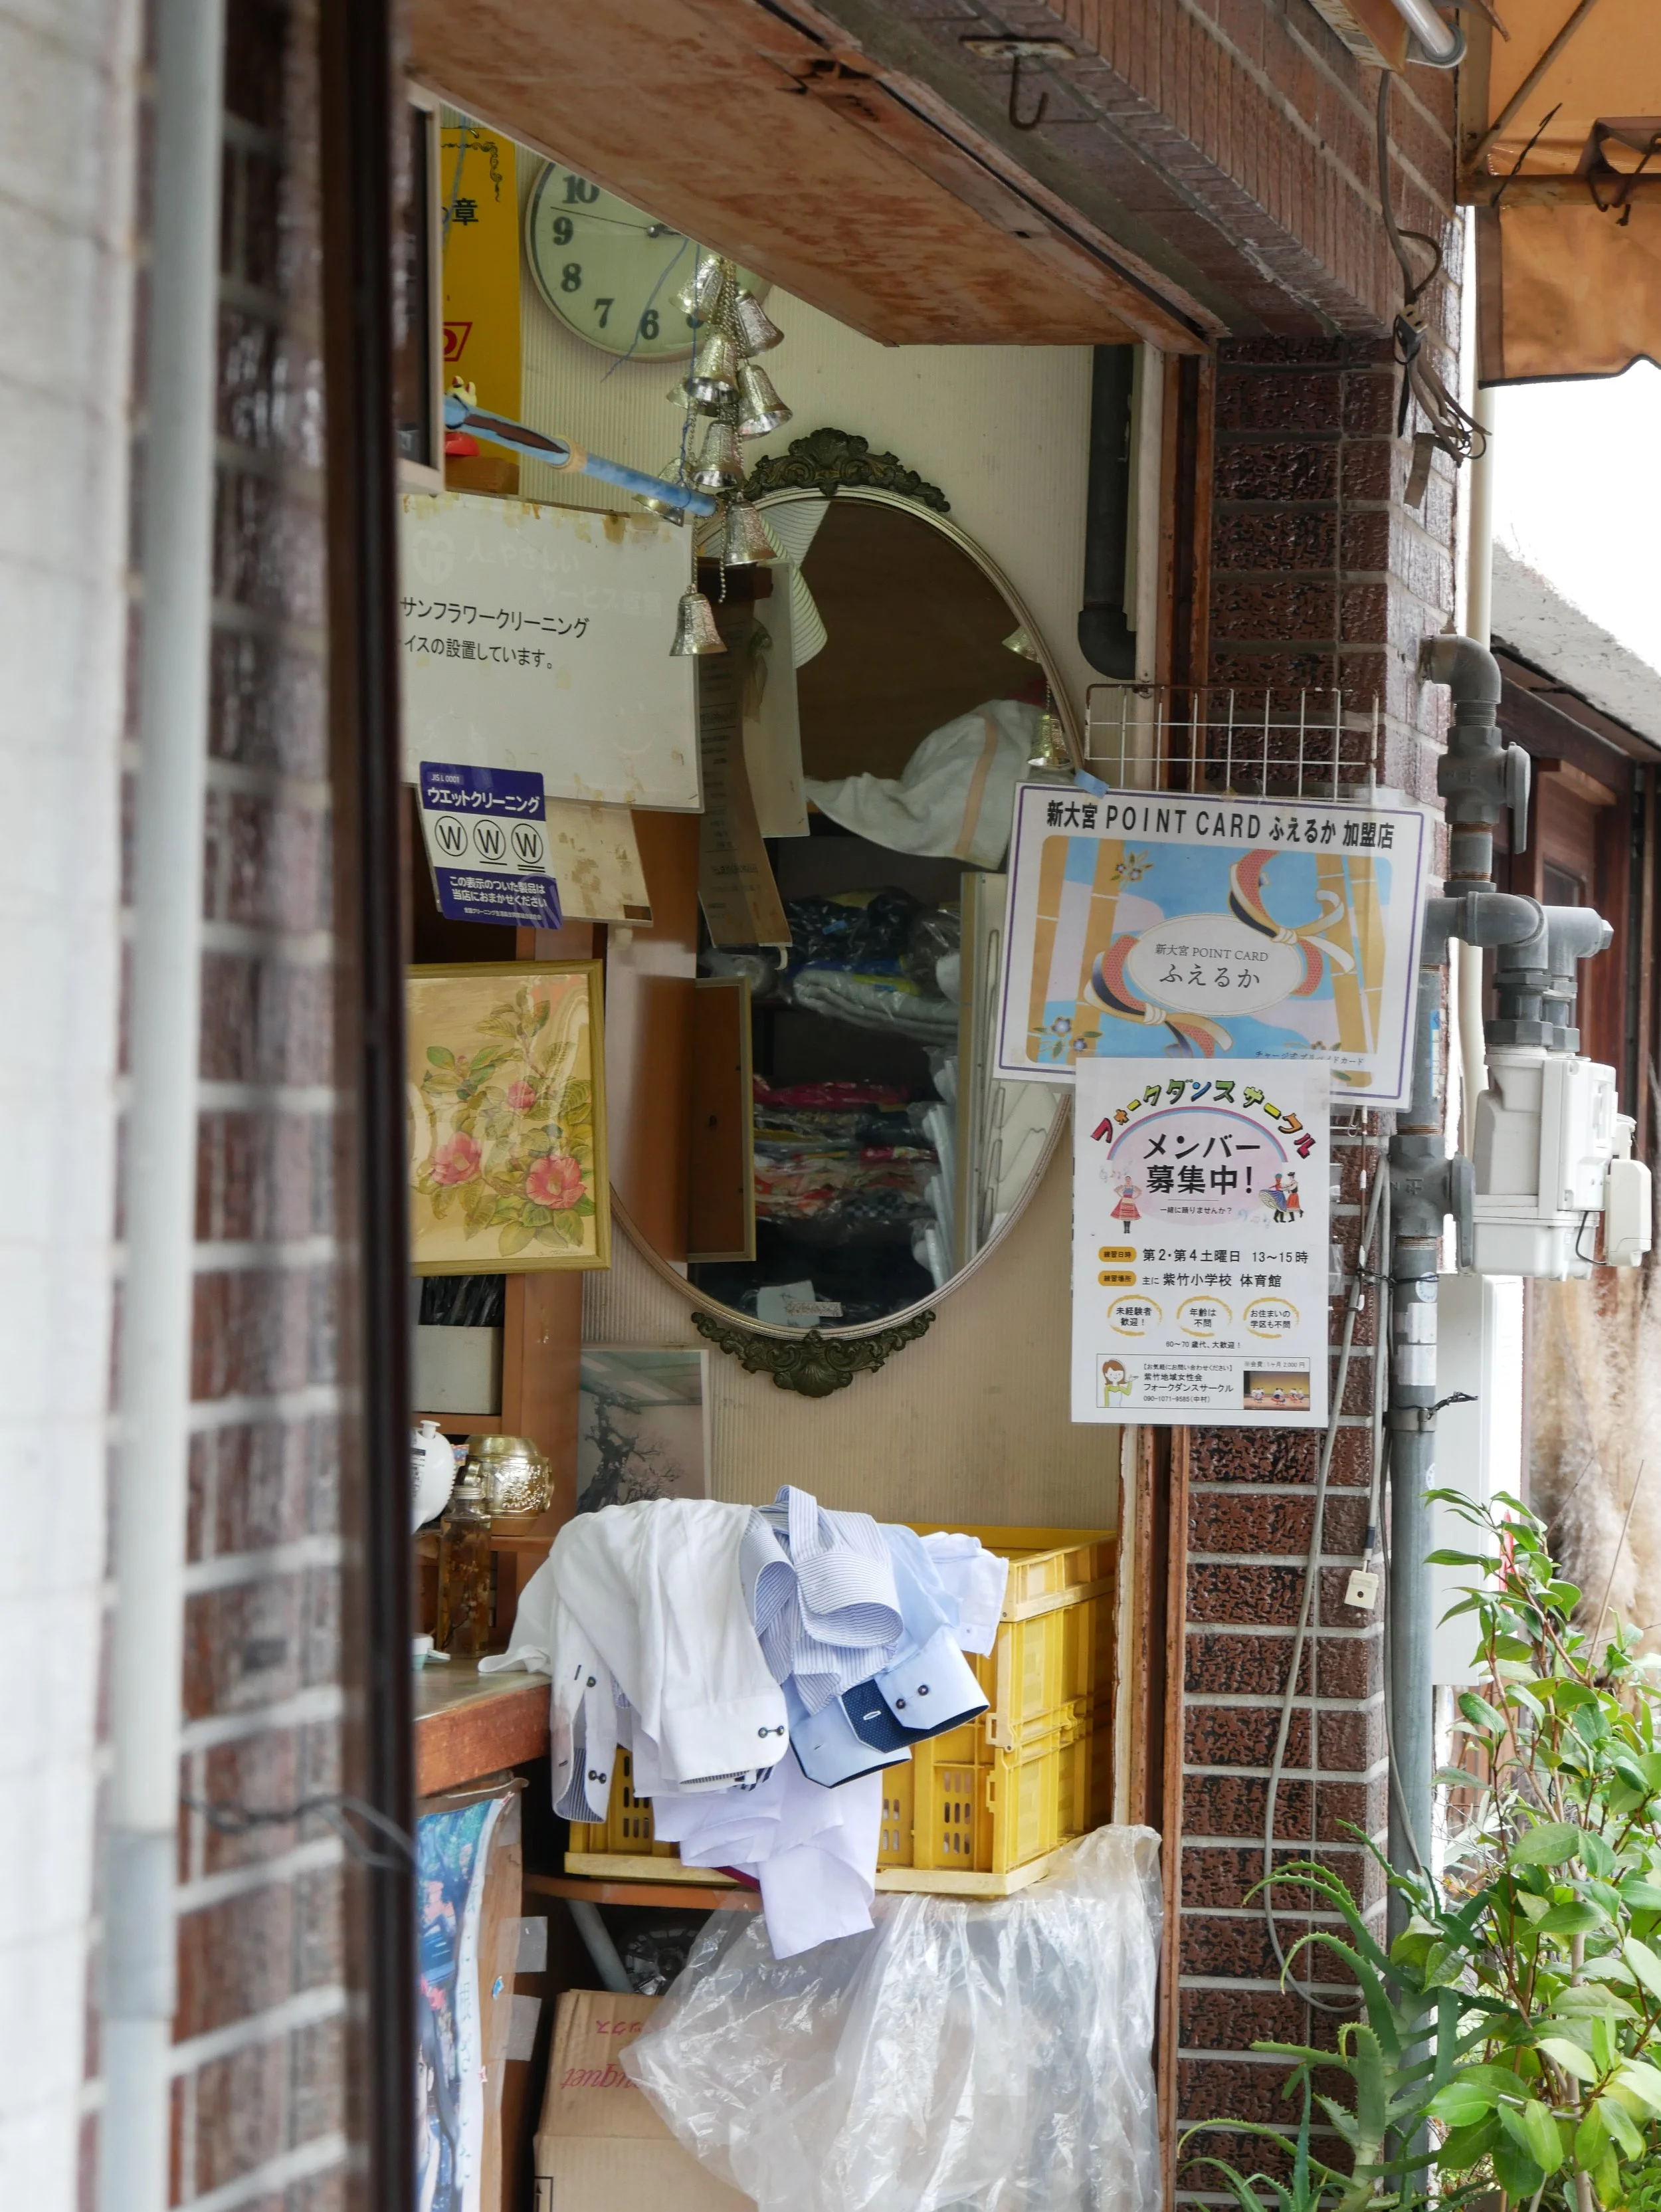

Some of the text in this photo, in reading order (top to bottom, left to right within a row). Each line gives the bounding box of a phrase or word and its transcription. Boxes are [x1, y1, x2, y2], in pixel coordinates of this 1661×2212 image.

[562, 175, 599, 204] 10
[553, 217, 573, 245] 9
[561, 263, 581, 292] 8
[594, 298, 615, 328] 7
[640, 310, 659, 340] 6
[400, 597, 589, 639] サンフラワークリーニング
[427, 787, 540, 813] ウエットクリーニング
[1047, 799, 1395, 849] 新大宮 POINT CARD ふえるか 加盟店
[449, 876, 546, 894] この表示のついた製品は
[452, 888, 547, 908] 当店におまかせください
[1155, 944, 1269, 961] 新大宮 POINT CARD
[1159, 963, 1260, 988] ふえるか
[1143, 1134, 1260, 1159] メンバー
[1146, 1165, 1252, 1195] 募集中！
[1240, 1274, 1282, 1288] 体育館
[1116, 1307, 1152, 1316] 未経験者
[1189, 1308, 1217, 1317] 年齢は
[1194, 1319, 1212, 1328] 不問
[1250, 1320, 1291, 1329] 学区も不問
[1143, 1383, 1234, 1393] フォークダンスサークル
[1144, 1373, 1203, 1381] 紫竹地域女性会
[596, 2020, 643, 2036] ックス
[561, 2063, 640, 2090] uquet
